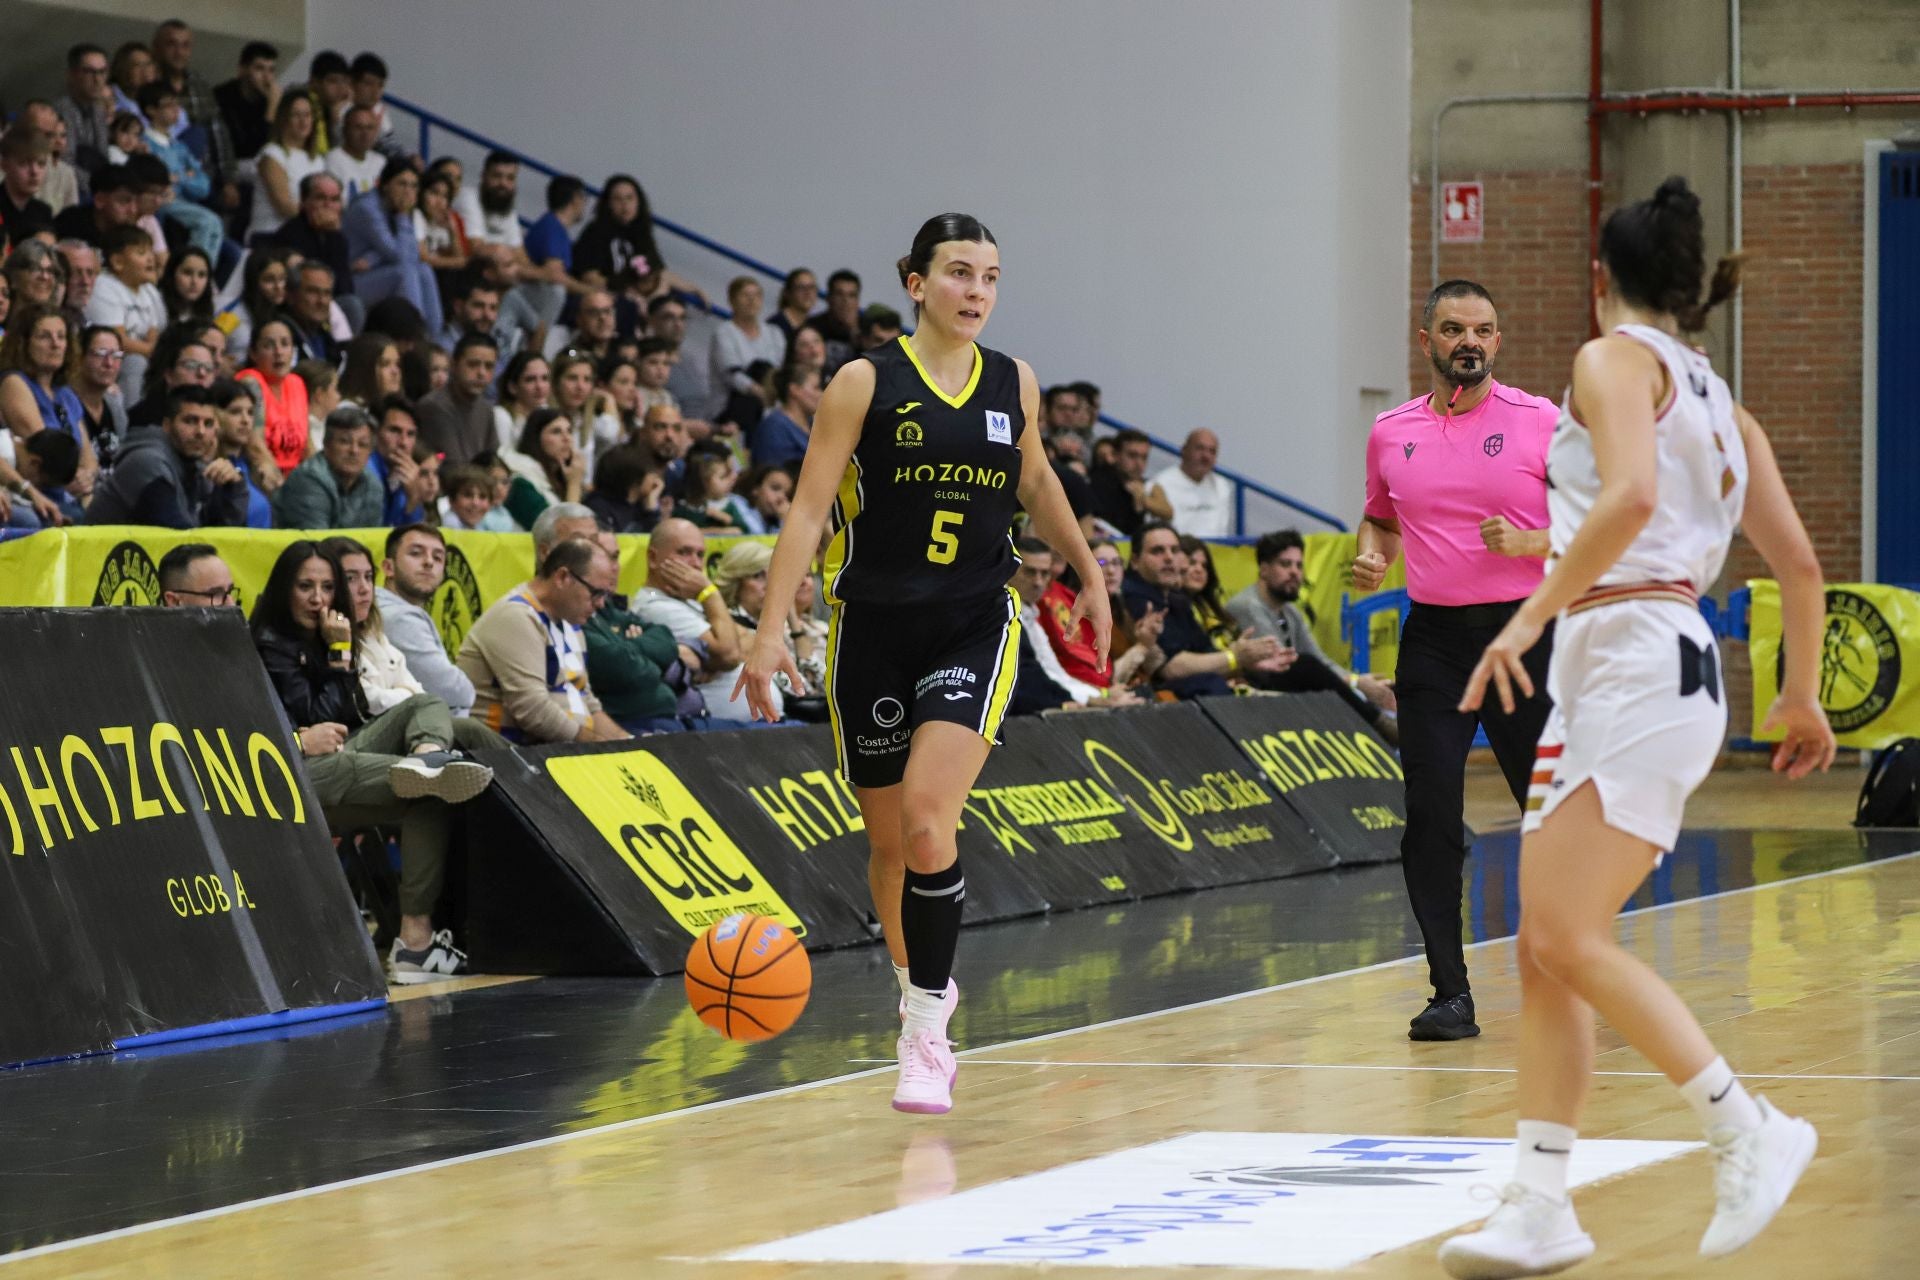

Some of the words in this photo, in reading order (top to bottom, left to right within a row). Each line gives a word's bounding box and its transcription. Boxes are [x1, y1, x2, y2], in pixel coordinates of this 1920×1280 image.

[895, 464, 1006, 489] HOZONO
[934, 490, 971, 501] GLOBAL
[927, 510, 964, 565] 5
[857, 735, 890, 747] Costa
[1241, 729, 1404, 793] HOZONO
[10, 722, 305, 850] HOZONO
[1001, 777, 1127, 827] ESTRELLA
[619, 817, 754, 901] CRC
[166, 868, 256, 918] GLOBAL
[1309, 1138, 1516, 1163] LF
[948, 1188, 1297, 1260] endesa
